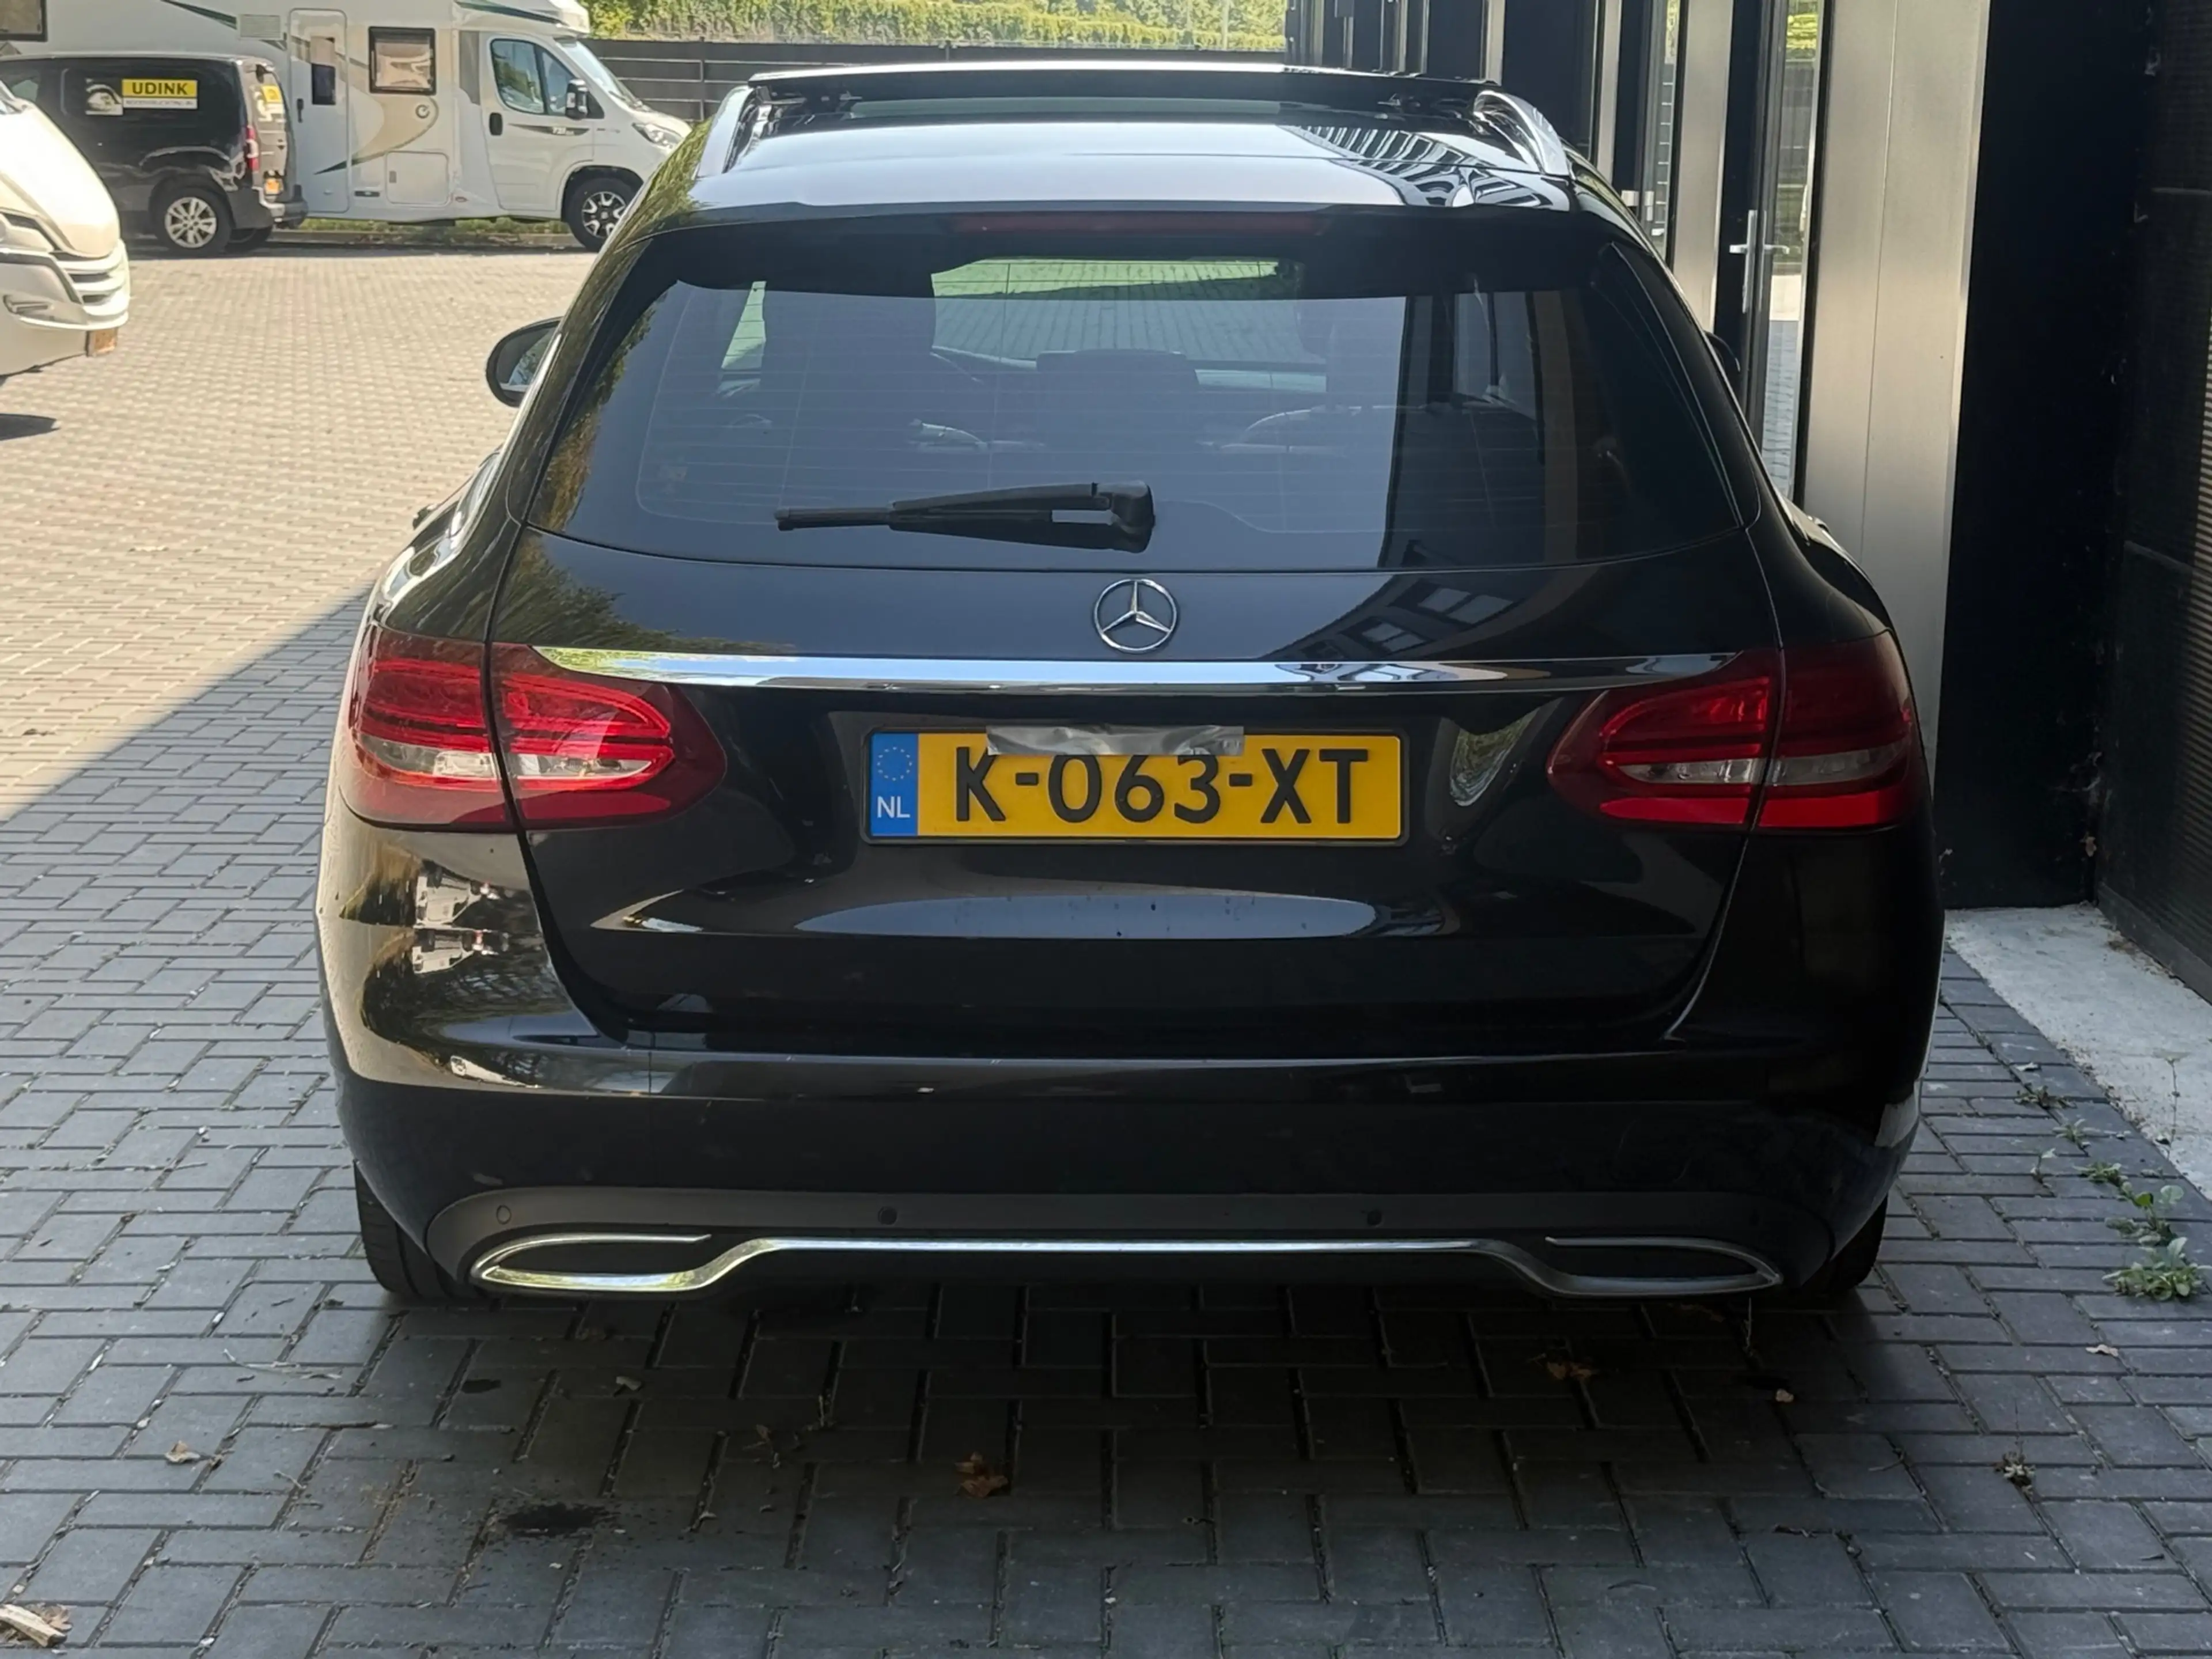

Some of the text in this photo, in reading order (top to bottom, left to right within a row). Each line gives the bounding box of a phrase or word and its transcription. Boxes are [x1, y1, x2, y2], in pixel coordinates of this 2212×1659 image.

[132, 82, 188, 95] UDINK
[956, 747, 1369, 824] K-063-XT
[877, 796, 911, 819] NL
